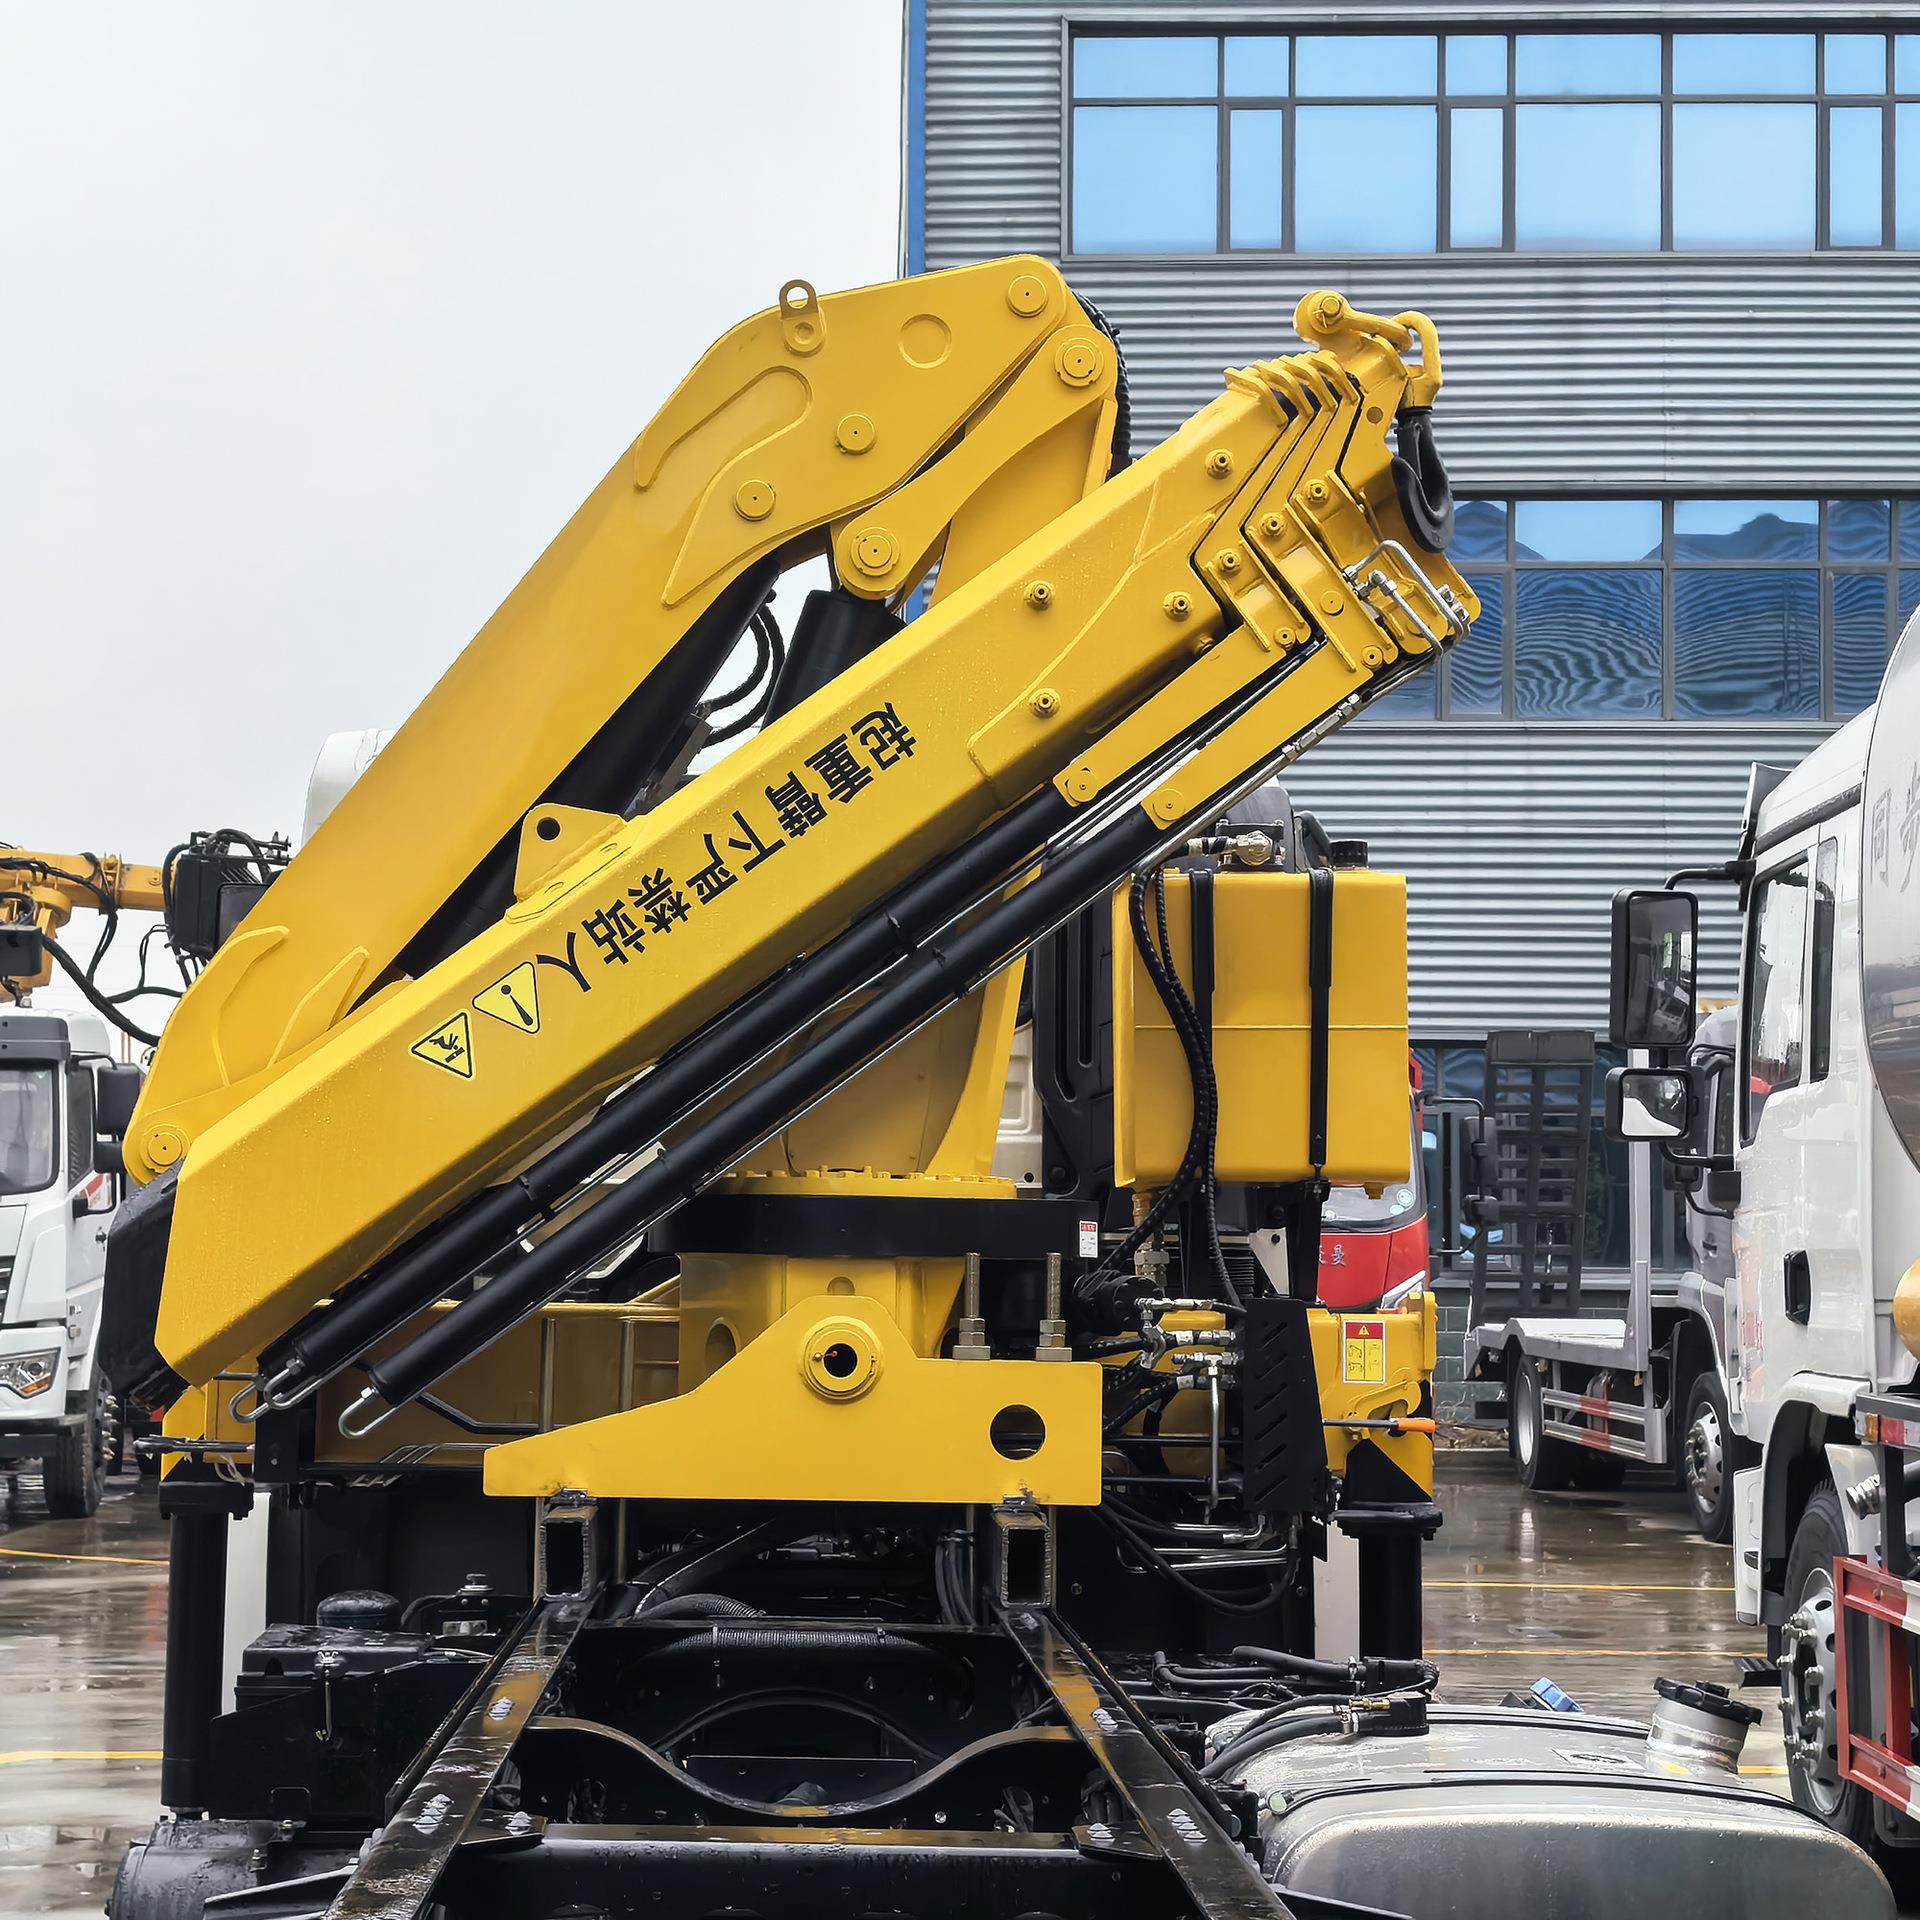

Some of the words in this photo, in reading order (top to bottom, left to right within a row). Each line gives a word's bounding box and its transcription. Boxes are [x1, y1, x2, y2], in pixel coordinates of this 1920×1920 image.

[536, 702, 917, 993] 起重臂下严禁站人
